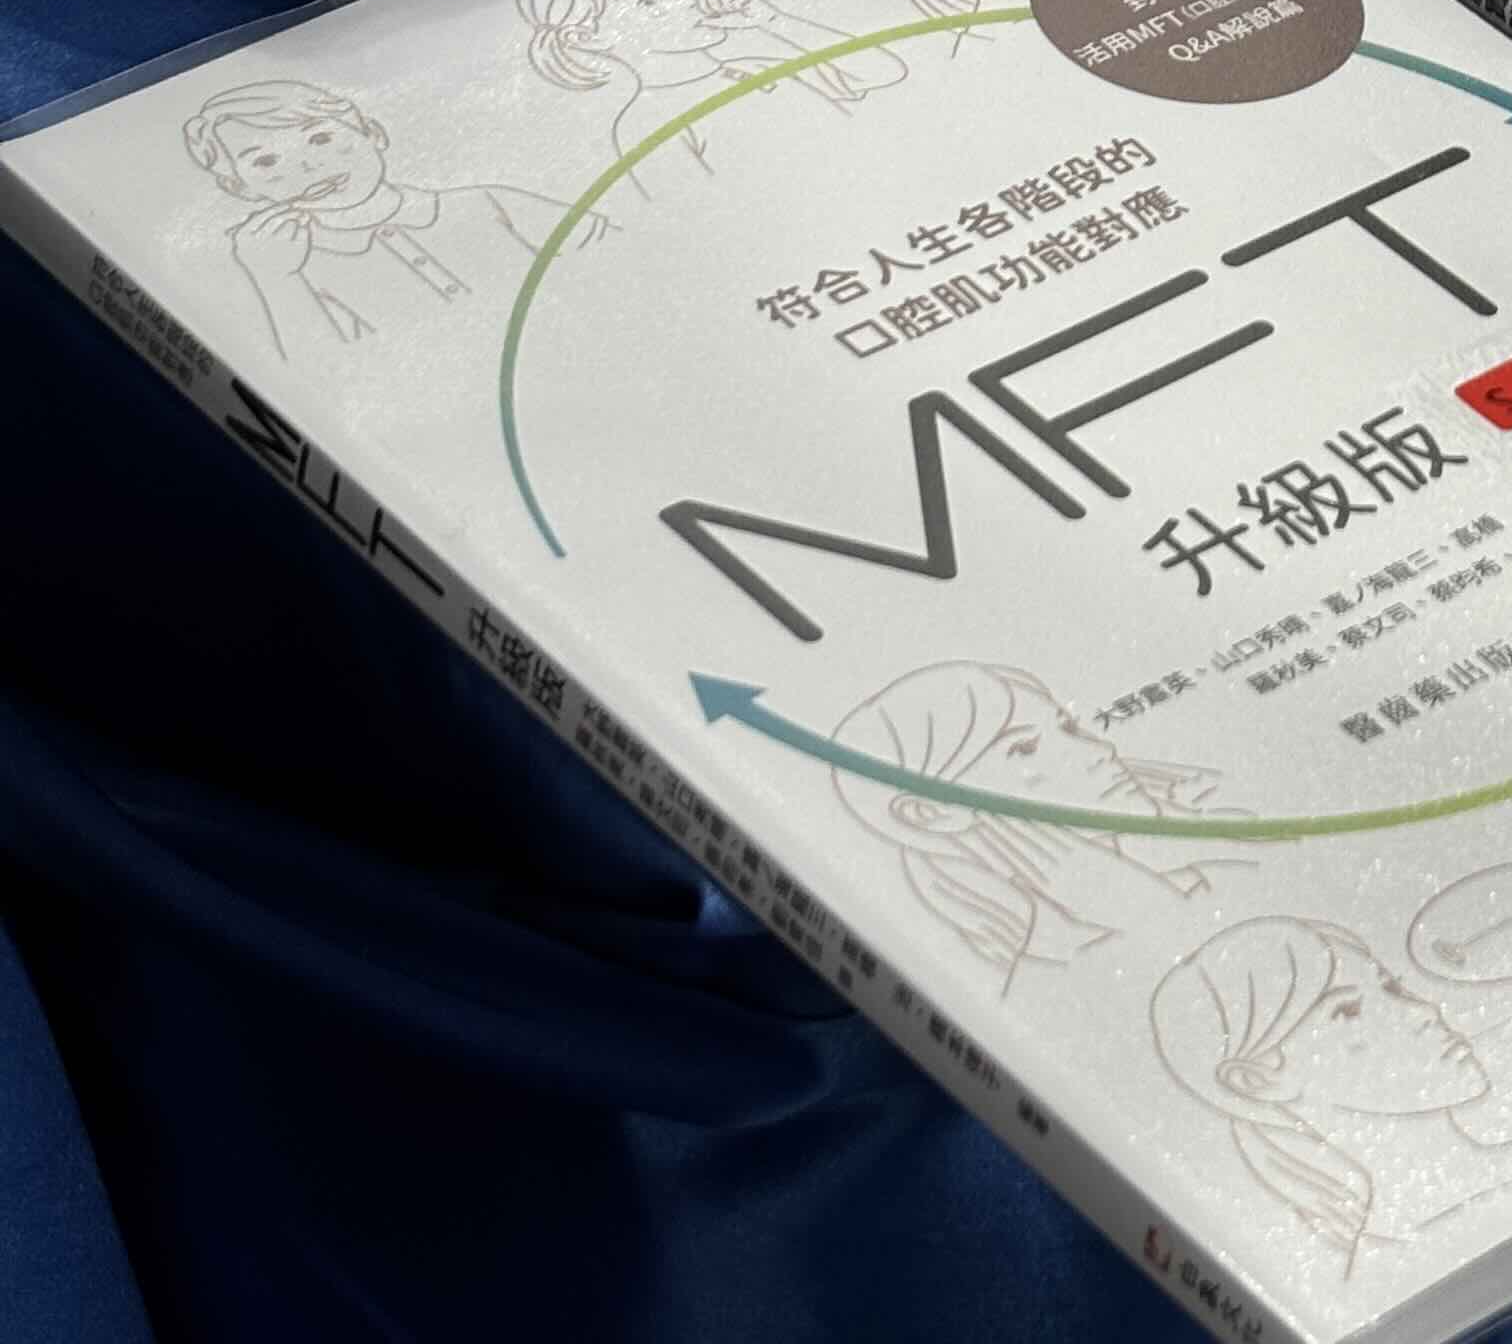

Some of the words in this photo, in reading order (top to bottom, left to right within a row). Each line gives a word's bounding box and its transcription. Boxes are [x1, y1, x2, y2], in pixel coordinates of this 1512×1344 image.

[755, 134, 1159, 331] 符合人生各階段的
[832, 184, 1189, 364] 口腔肌功能對應
[658, 145, 1499, 644] MFT
[1142, 405, 1469, 598] 升級版
